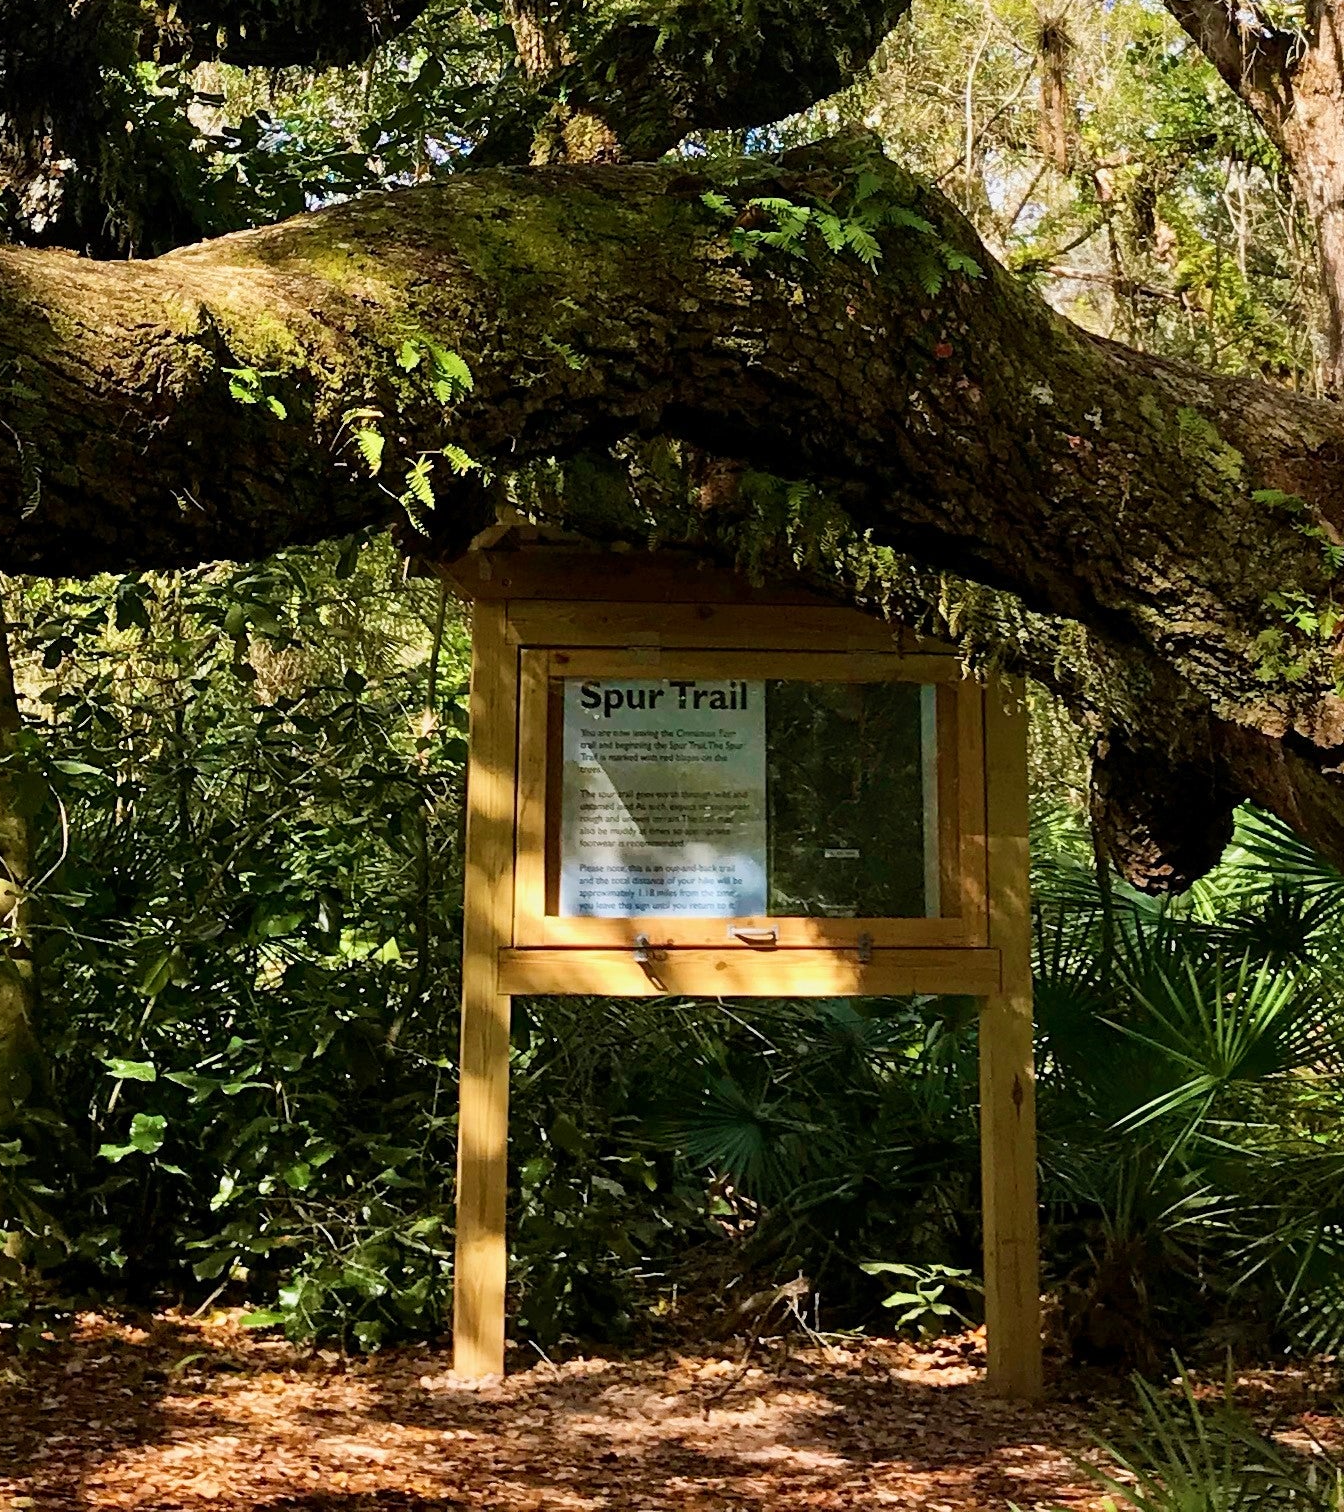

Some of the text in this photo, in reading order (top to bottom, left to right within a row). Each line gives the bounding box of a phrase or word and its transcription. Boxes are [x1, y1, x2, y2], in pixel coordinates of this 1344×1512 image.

[581, 681, 748, 718] Spur Trail
[661, 729, 674, 737] the
[654, 741, 668, 749] the
[669, 741, 687, 750] Spur
[708, 741, 724, 749] The
[726, 741, 744, 750] Spur
[580, 752, 598, 761] Trail
[608, 753, 638, 761] marked
[640, 753, 658, 761] with
[659, 753, 674, 761] red
[580, 789, 596, 798] The
[580, 815, 603, 825] rough
[605, 815, 620, 823] and
[580, 827, 596, 835] also
[597, 827, 608, 835] be
[579, 839, 616, 847] footwear
[580, 863, 605, 872] Please
[628, 864, 643, 872] this
[645, 864, 652, 872] is
[580, 876, 593, 884] and
[595, 876, 609, 884] the
[611, 876, 630, 884] total
[631, 876, 665, 885] distance
[666, 876, 676, 884] of
[677, 878, 696, 887] your
[717, 876, 731, 884] will
[733, 876, 743, 884] be
[579, 889, 636, 899] approximately
[656, 889, 677, 897] miles
[678, 889, 699, 897] from
[579, 903, 594, 913] you
[618, 902, 632, 910] this
[634, 902, 650, 912] sign
[652, 901, 671, 910] until
[672, 903, 687, 912] you
